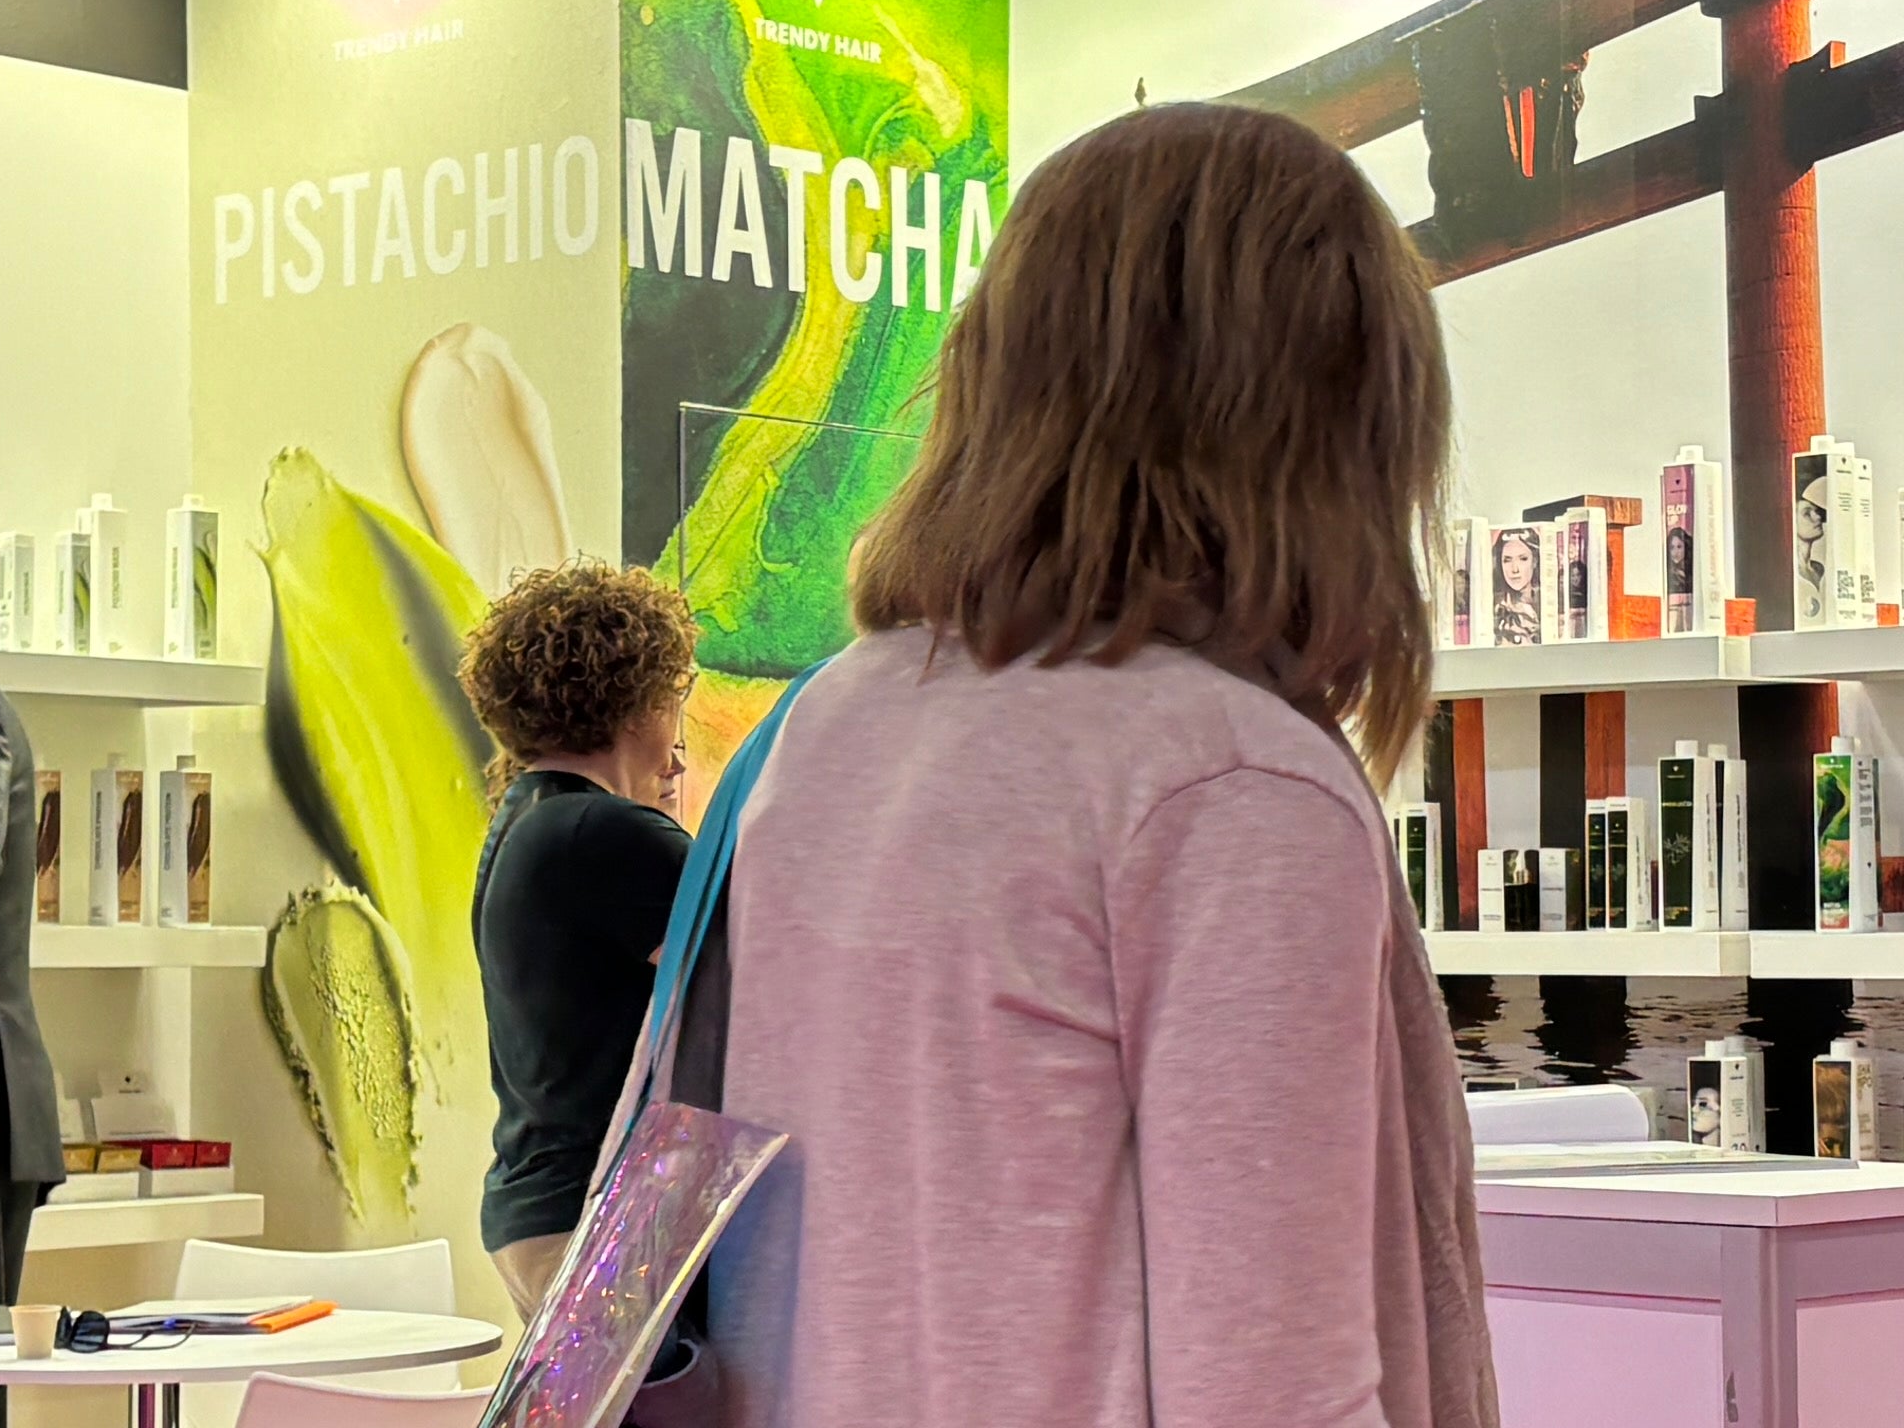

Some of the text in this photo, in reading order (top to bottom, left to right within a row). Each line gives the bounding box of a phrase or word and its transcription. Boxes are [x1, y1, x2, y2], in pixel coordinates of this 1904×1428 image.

[754, 18, 883, 65] TRENDY HAIR
[213, 134, 600, 305] PISTACHIO
[624, 117, 992, 313] MATCHA
